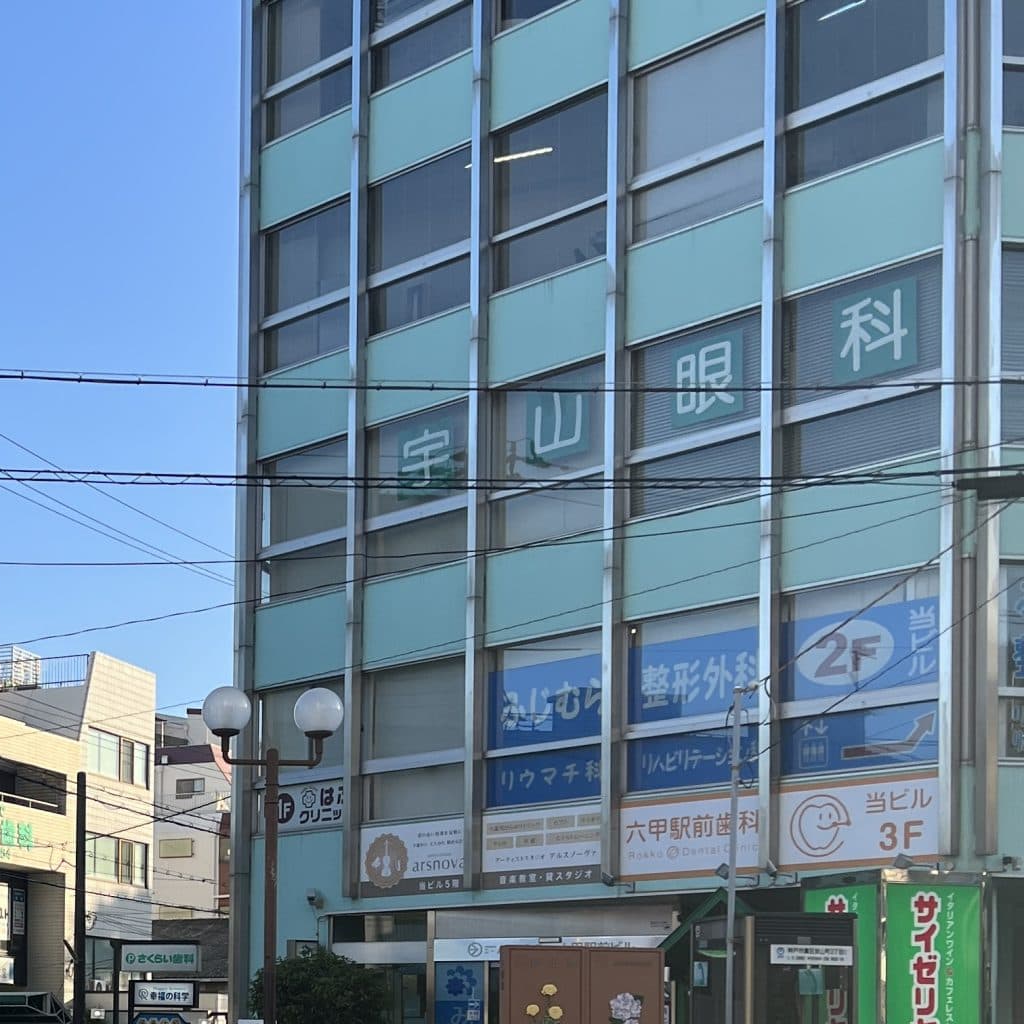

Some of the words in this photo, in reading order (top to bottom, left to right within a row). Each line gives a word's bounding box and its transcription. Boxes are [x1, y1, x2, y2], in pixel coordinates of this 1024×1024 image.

[813, 632, 881, 679] 2F
[909, 604, 937, 677] 当ビル
[501, 759, 602, 791] リウマチ科
[865, 788, 933, 815] 当ビル
[626, 809, 759, 843] 六甲駅前歯科
[879, 820, 924, 852] 3F
[412, 857, 465, 873] arsnova
[138, 953, 194, 964] さくらい歯科
